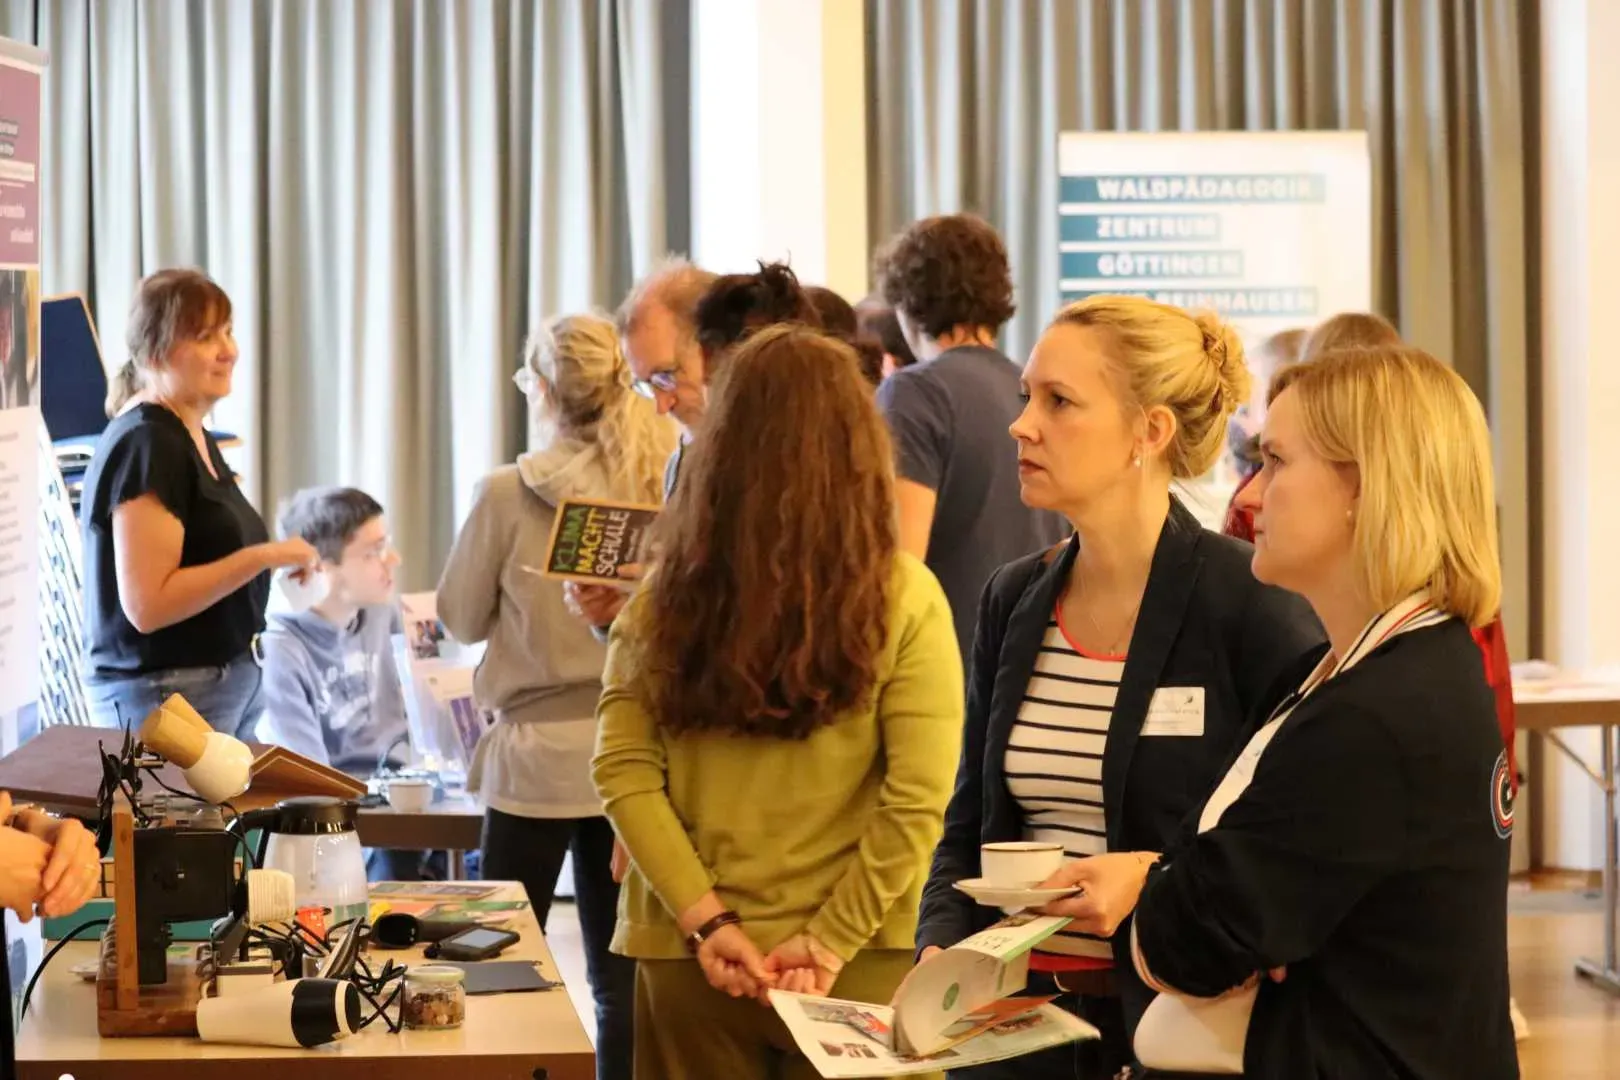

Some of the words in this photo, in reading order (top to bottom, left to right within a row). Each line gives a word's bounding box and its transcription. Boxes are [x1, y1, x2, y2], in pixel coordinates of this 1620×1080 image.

[1096, 216, 1215, 238] ZENTRUM
[1096, 252, 1238, 276] GÖTTINGEN
[575, 507, 608, 574] MACHT
[595, 510, 631, 577] SCHULE
